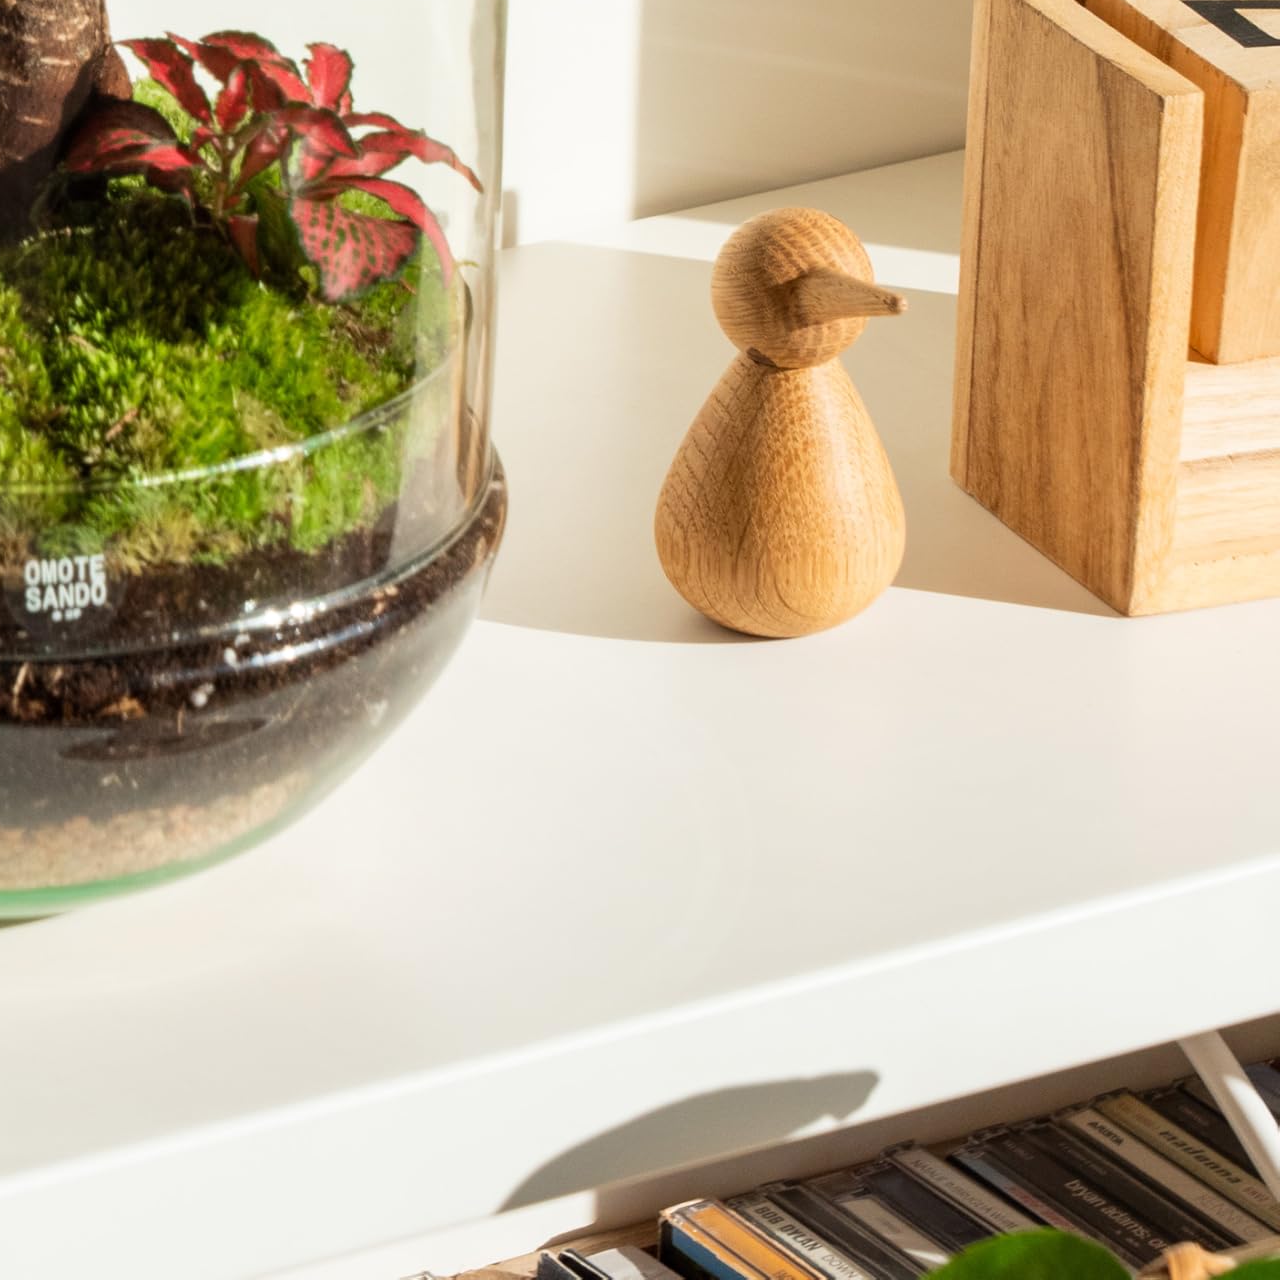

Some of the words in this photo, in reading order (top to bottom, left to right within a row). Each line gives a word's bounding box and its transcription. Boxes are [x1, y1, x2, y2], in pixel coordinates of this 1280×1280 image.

[24, 554, 106, 586] OMOTE
[25, 581, 107, 613] SANDO
[1159, 1129, 1241, 1184] madonna
[1063, 1178, 1107, 1208] bryan
[754, 1206, 785, 1225] BOB
[778, 1223, 823, 1252] DYLAN
